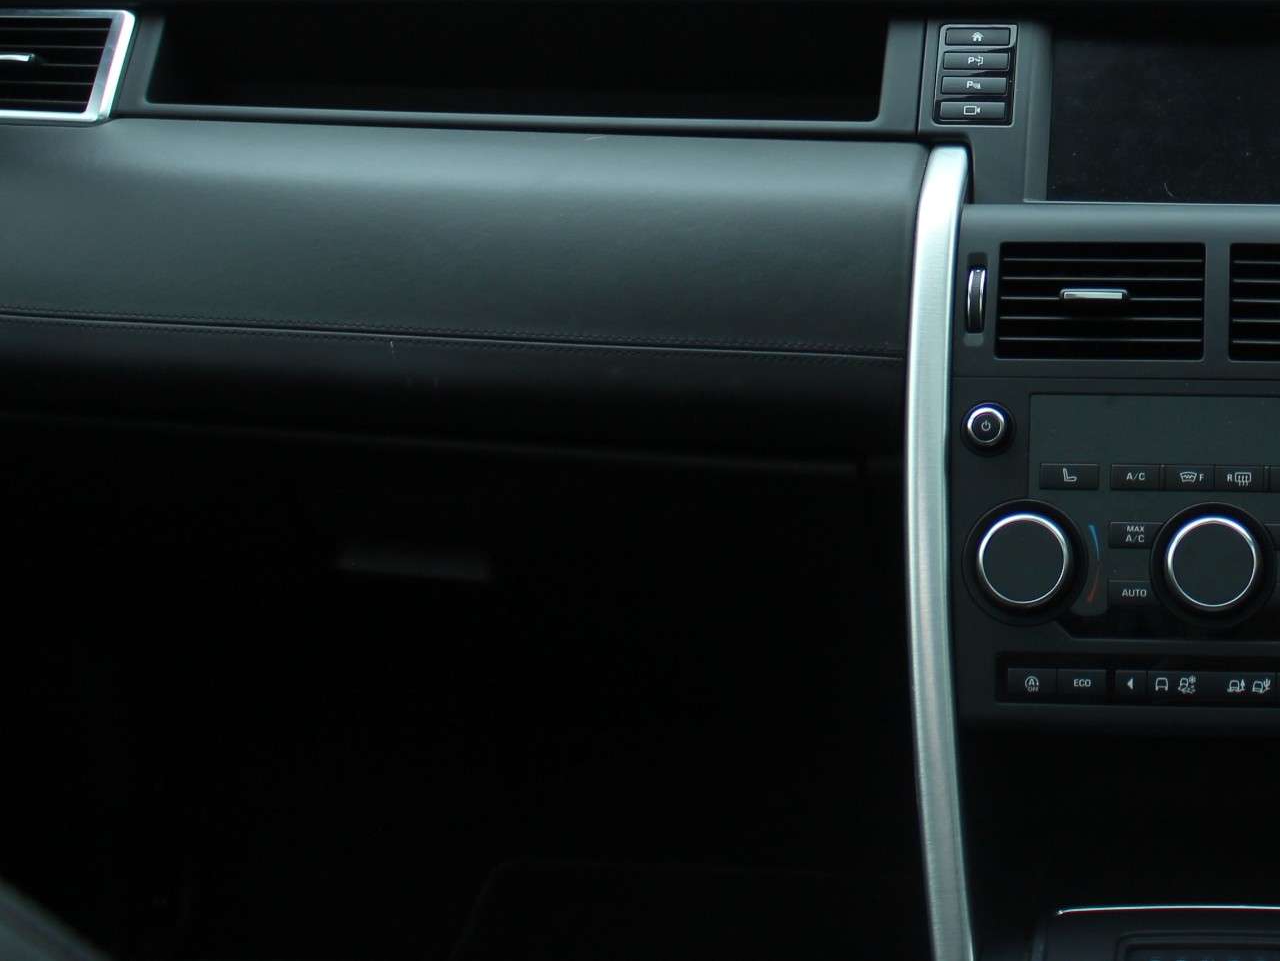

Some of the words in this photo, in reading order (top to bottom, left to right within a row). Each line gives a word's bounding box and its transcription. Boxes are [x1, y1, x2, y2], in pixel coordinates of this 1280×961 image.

[1126, 471, 1146, 482] A/C
[1126, 525, 1145, 533] MAX
[1125, 534, 1145, 544] A/C
[1121, 588, 1147, 598] AUTO
[1073, 678, 1091, 688] ECO
